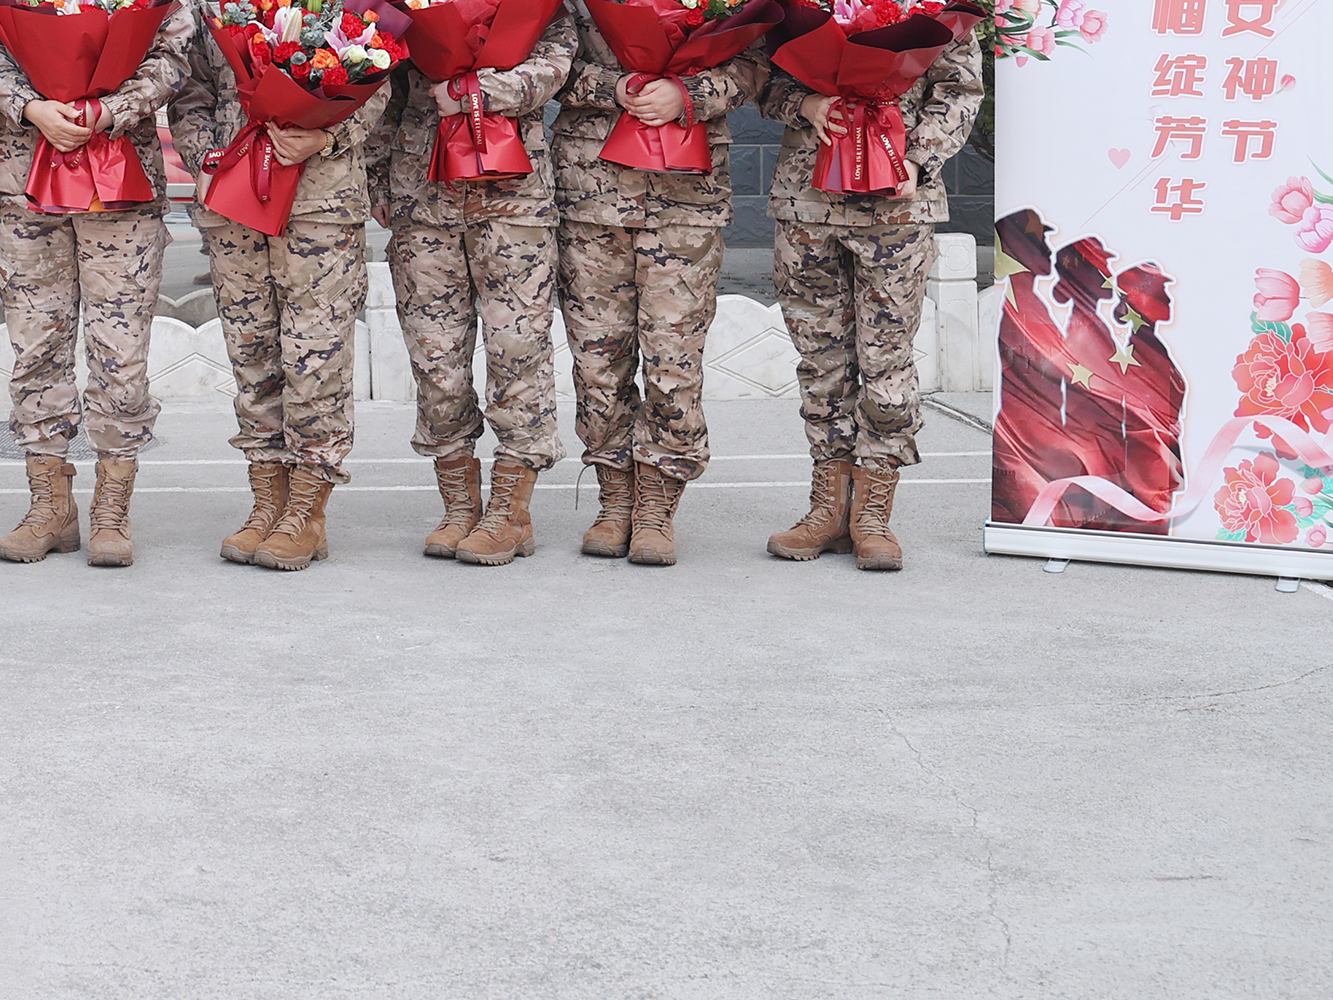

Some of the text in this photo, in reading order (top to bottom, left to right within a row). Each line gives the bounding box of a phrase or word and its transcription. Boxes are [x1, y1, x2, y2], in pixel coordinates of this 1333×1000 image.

[471, 93, 480, 109] LOVE
[880, 134, 891, 151] LOVE
[263, 154, 271, 170] LOVE
[854, 164, 862, 180] LOVE
